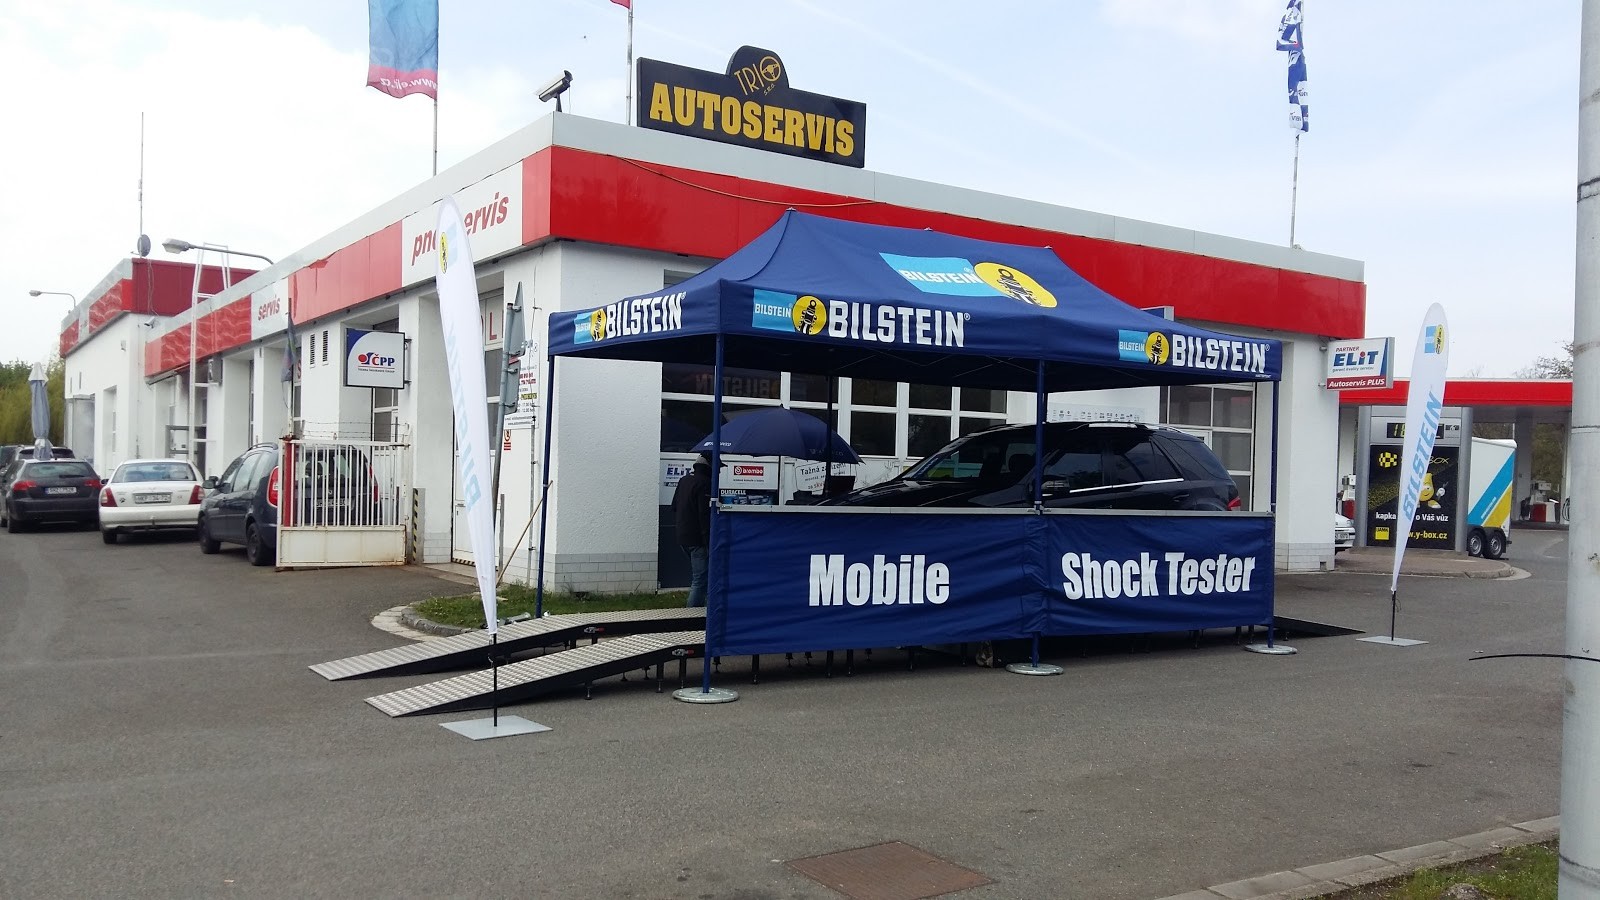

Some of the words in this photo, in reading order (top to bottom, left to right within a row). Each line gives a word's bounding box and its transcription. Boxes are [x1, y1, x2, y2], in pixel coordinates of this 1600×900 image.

[734, 55, 781, 96] TRIO
[649, 82, 855, 158] AUTOSERVIS
[898, 268, 984, 284] BILSTEIN
[258, 294, 281, 321] servis
[754, 302, 793, 319] BILSTEIN
[1119, 341, 1145, 352] BILSTEIN
[371, 353, 395, 366] ČPP
[1328, 379, 1367, 388] Autoservis
[1367, 378, 1386, 386] PLUS
[1402, 390, 1442, 522] BILSTEIN
[742, 467, 764, 475] brembo
[1375, 511, 1397, 521] kapka
[1422, 512, 1435, 521] Váš
[1436, 512, 1449, 522] vůz
[1408, 531, 1448, 541] w.y-box.cz
[809, 553, 950, 607] Mobile
[1061, 551, 1159, 600] Shock
[1164, 552, 1256, 596] Tester
